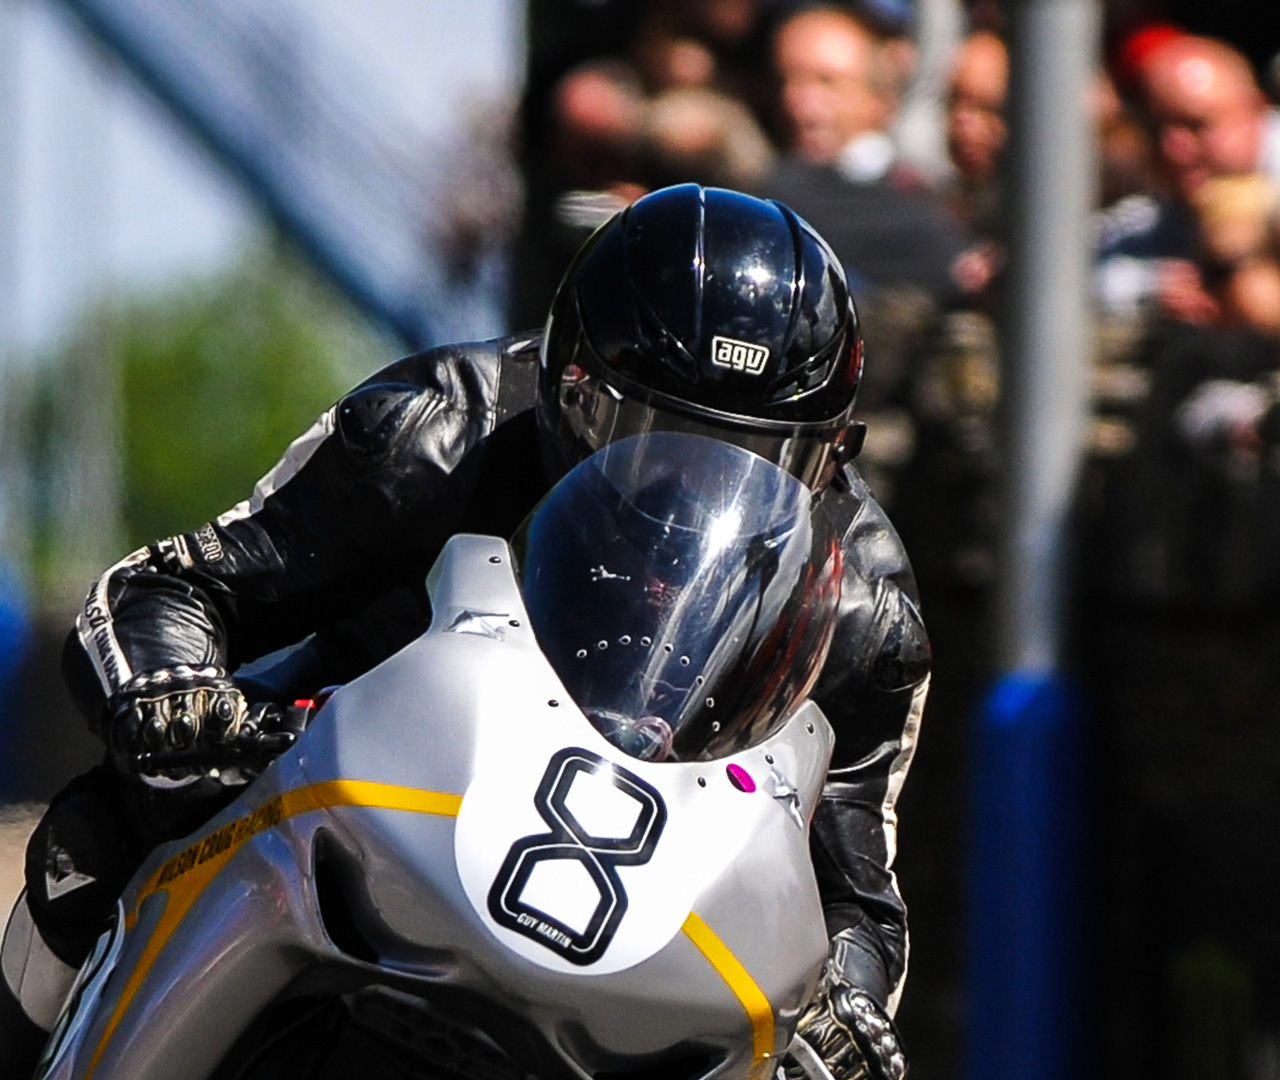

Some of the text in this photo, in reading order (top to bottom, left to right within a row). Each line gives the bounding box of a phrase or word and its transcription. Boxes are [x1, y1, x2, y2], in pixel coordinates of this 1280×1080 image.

[716, 341, 764, 371] agv
[487, 747, 667, 966] 8
[517, 913, 572, 949] GUY MARTIN
